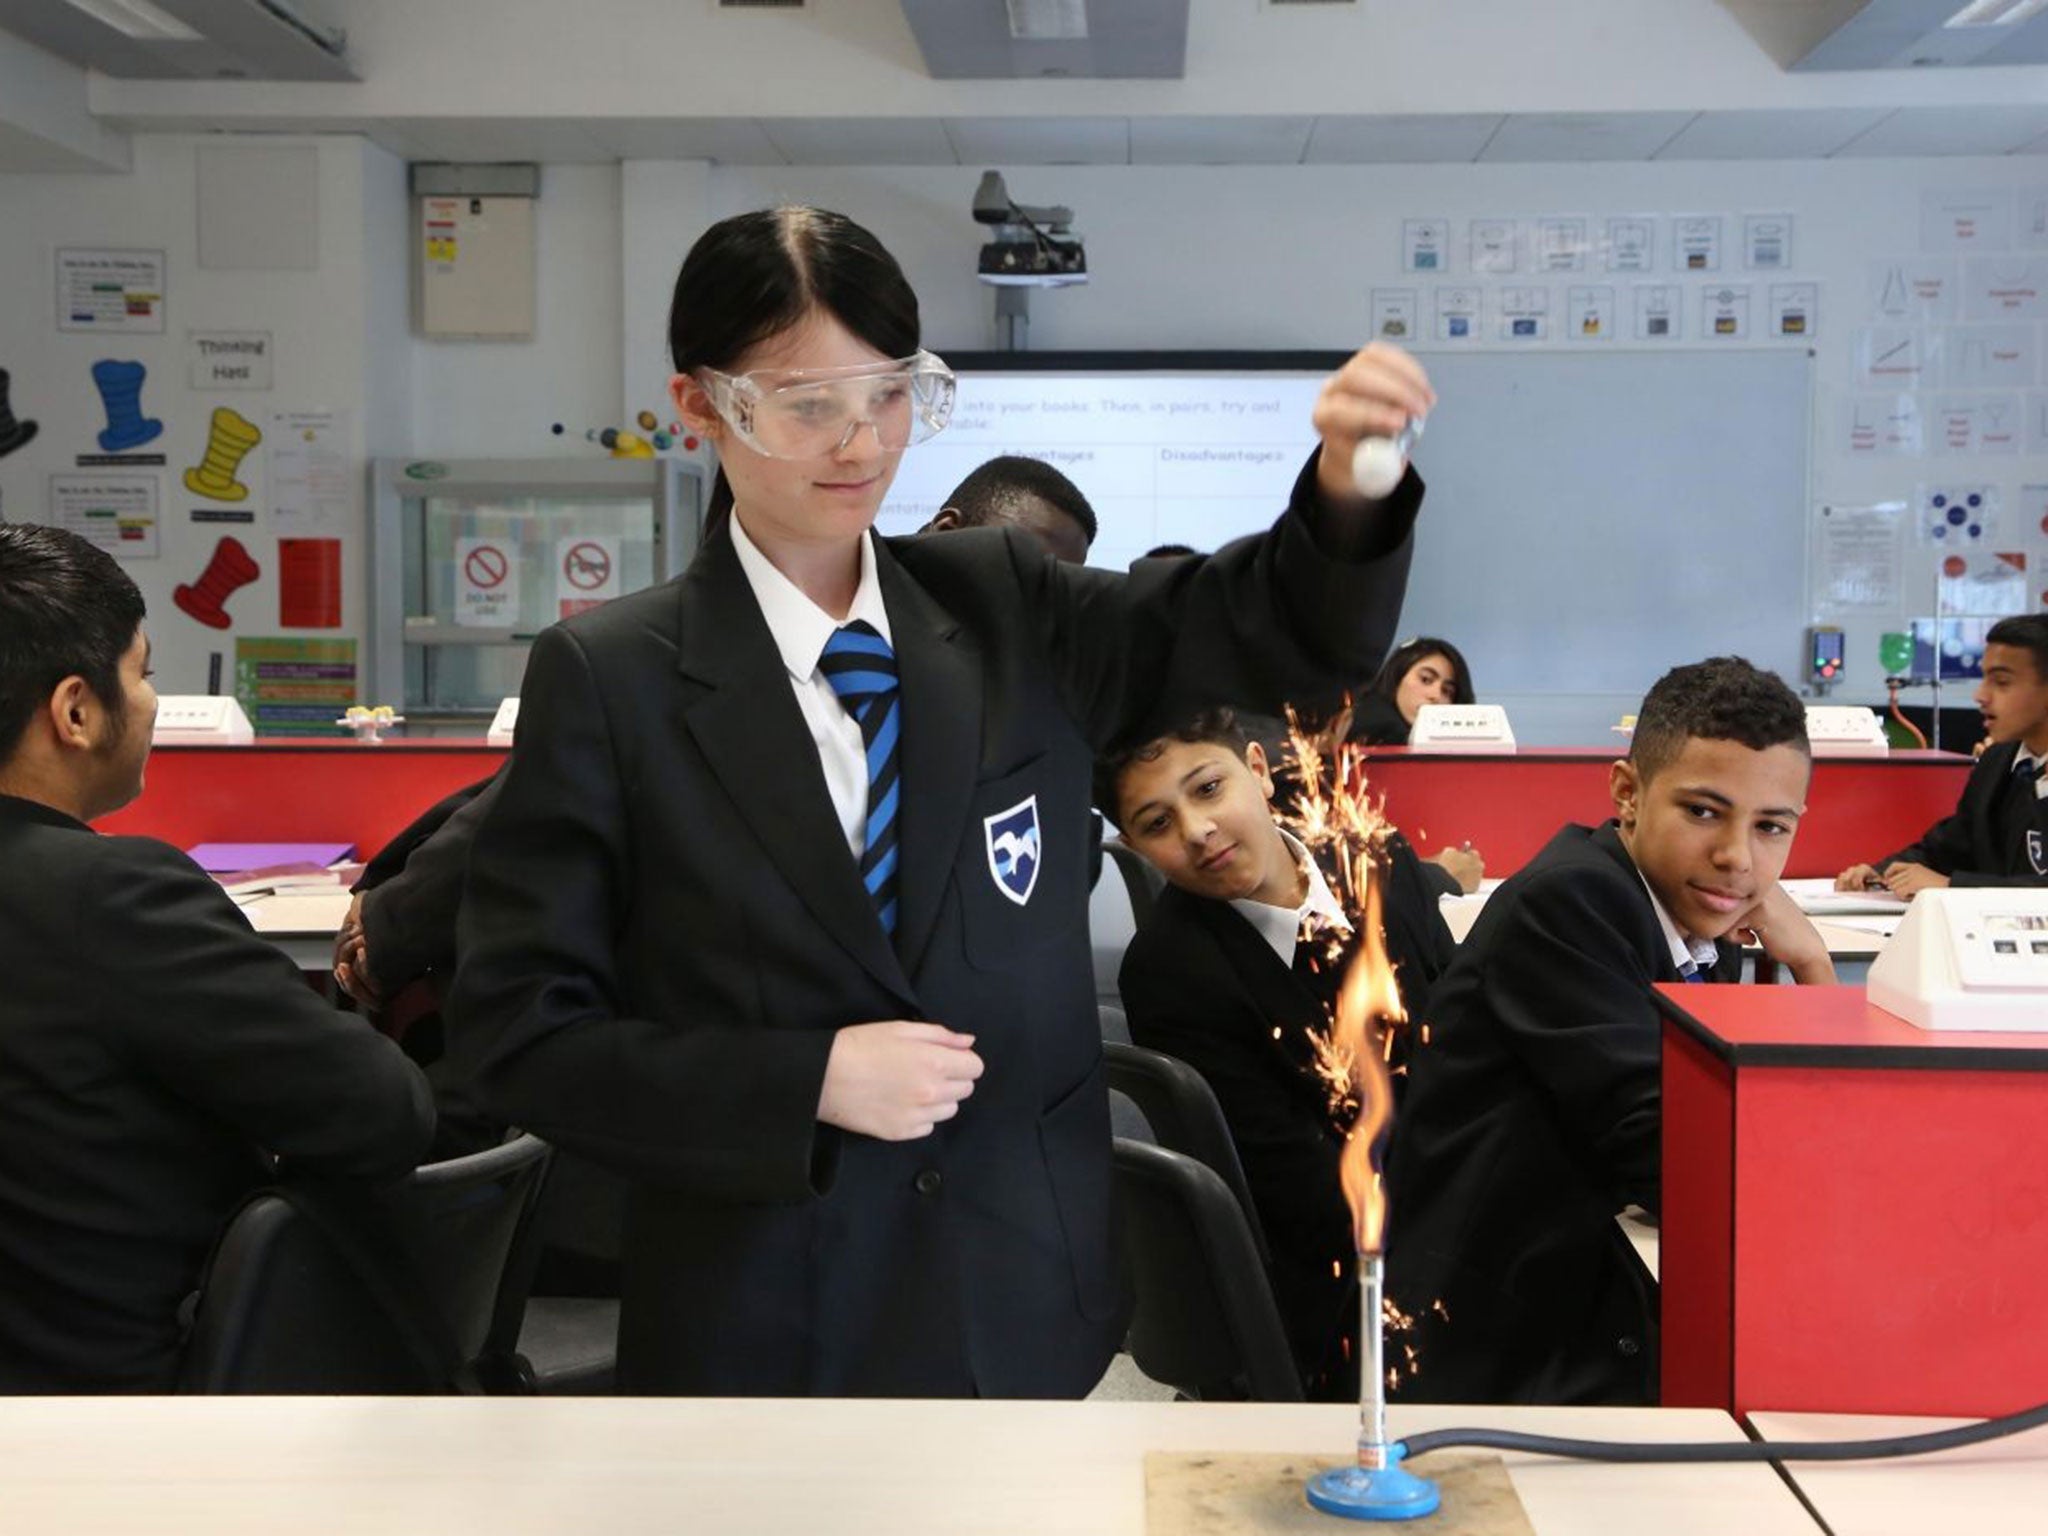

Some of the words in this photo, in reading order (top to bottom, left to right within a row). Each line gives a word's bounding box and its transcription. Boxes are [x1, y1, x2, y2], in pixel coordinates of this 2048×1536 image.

[197, 339, 265, 356] Thinking
[212, 363, 250, 380] Hats
[963, 400, 994, 412] into
[1001, 402, 1035, 416] your
[1149, 401, 1165, 412] in
[1221, 401, 1246, 417] try
[1252, 399, 1280, 412] and
[1161, 448, 1285, 463] Disadvantages
